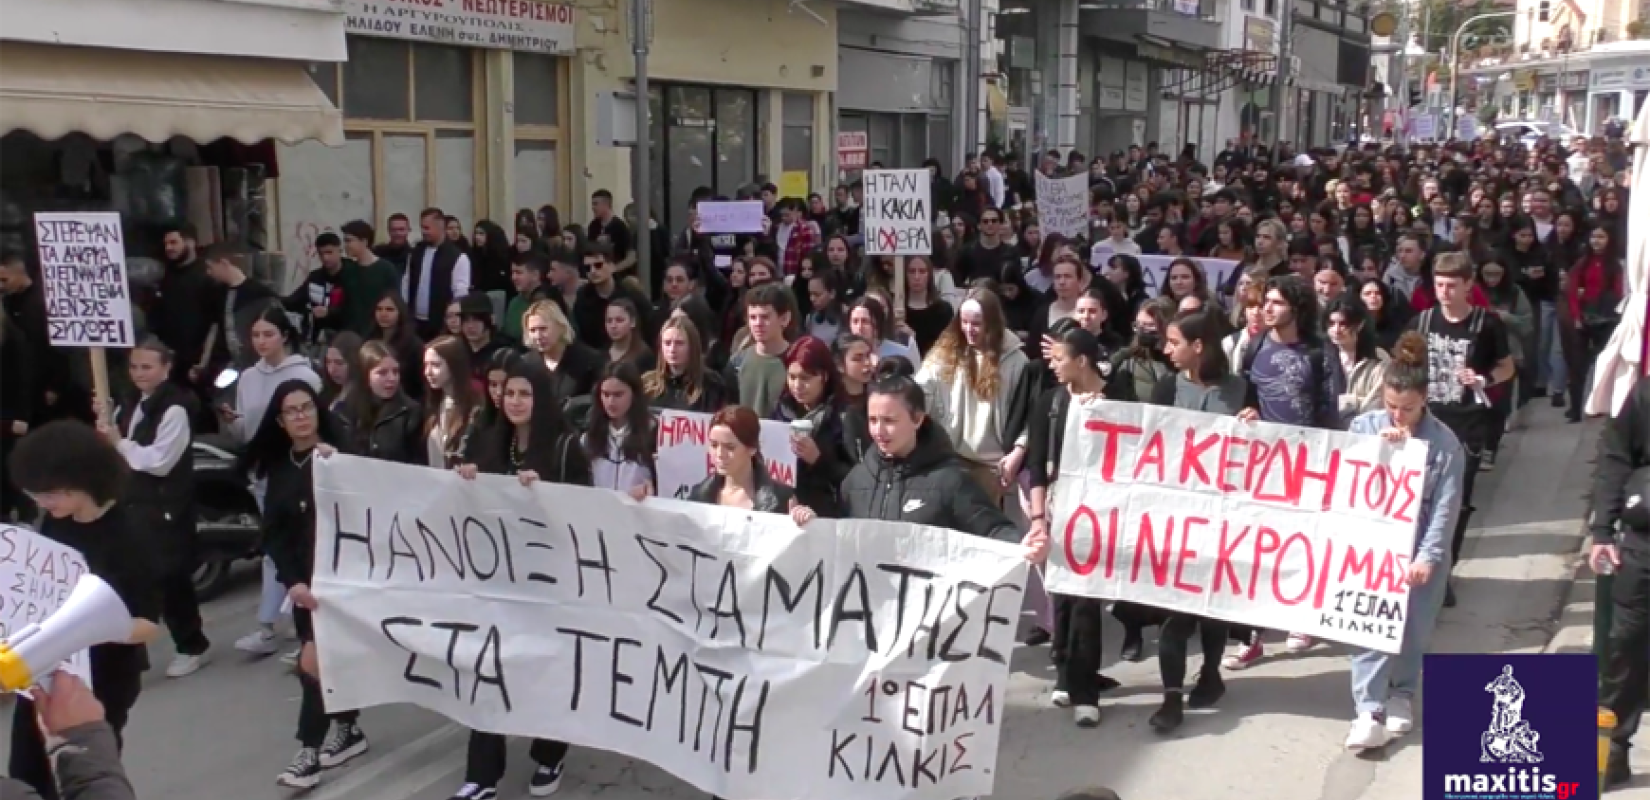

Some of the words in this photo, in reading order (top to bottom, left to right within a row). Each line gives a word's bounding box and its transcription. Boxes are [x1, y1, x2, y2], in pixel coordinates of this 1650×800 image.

[462, 0, 573, 24] ΝΕΩΤΕΡΙΣΜΟΙ
[489, 32, 559, 50] ΔΗΜΗΤΡΙΟΥ
[866, 197, 876, 218] Η
[881, 197, 926, 220] ΚΑΚΙΑ
[40, 245, 58, 262] ΤΑ
[58, 282, 86, 300] ΝΕΑ
[46, 298, 78, 318] ΔΕΝ
[80, 298, 112, 318] ΣΑΣ
[1084, 419, 1164, 483] ΤΑ
[1179, 427, 1341, 512] ΚΕΡΔΗ
[1345, 459, 1421, 523] ΤΟΥΣ
[1063, 504, 1118, 579] ΟΙ
[1130, 512, 1333, 609] ΝΕΚΡΟΙ
[1338, 544, 1410, 594] ΜΑΣ
[333, 501, 374, 580] Η
[386, 510, 617, 604] ΑΝΟΙΞΗ
[634, 533, 1023, 665] ΣΤΑΜΑΤΗΣΕ
[1320, 613, 1397, 641] ΚΙΛΚΙΣ
[381, 616, 511, 712] ΣΤΑ
[556, 627, 770, 774] ΤΕΜΠΗ
[902, 680, 995, 736] ΕΠΑΛ
